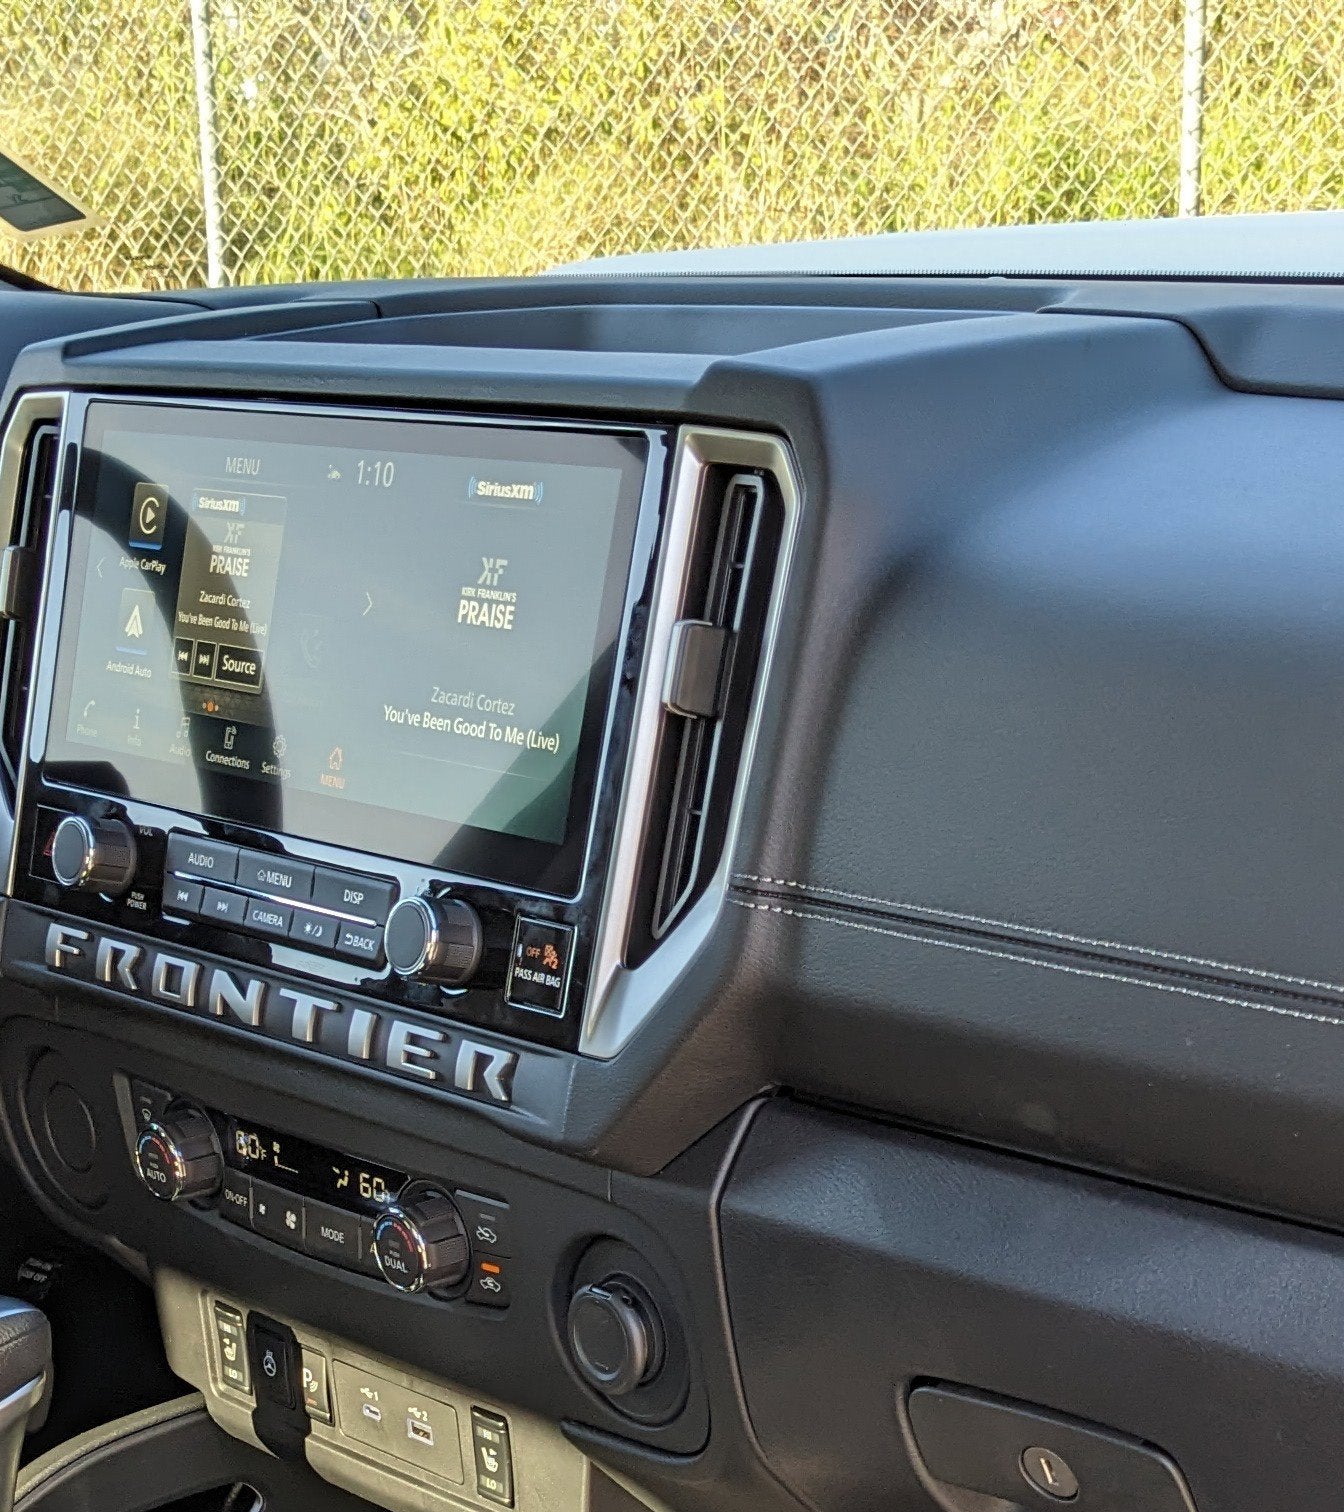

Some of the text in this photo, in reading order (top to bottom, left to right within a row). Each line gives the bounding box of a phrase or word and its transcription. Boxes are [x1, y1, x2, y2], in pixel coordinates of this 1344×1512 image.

[225, 455, 262, 476] MENU
[356, 459, 395, 489] 1:10
[119, 556, 167, 576] Apple CarPlay
[209, 554, 250, 577] PRAISE
[199, 590, 251, 609] Zacardi Cortez
[457, 599, 516, 631] PRAISE
[106, 660, 152, 679] Android Auto
[221, 654, 257, 676] Source
[431, 685, 516, 717] Zacardi Cortez
[383, 704, 561, 755] You've Been Good To Me (Live)
[205, 750, 250, 771] Connections
[261, 761, 292, 781] Settings
[187, 851, 215, 869] AUDIO
[266, 870, 292, 889] MENU
[343, 888, 365, 906] DISP
[252, 909, 284, 928] CAMERA
[353, 934, 376, 952] BACK
[46, 922, 518, 1101] FRONTIER
[146, 1168, 167, 1183] AUTO
[320, 1225, 345, 1245] MODE
[384, 1255, 408, 1274] DUAL
